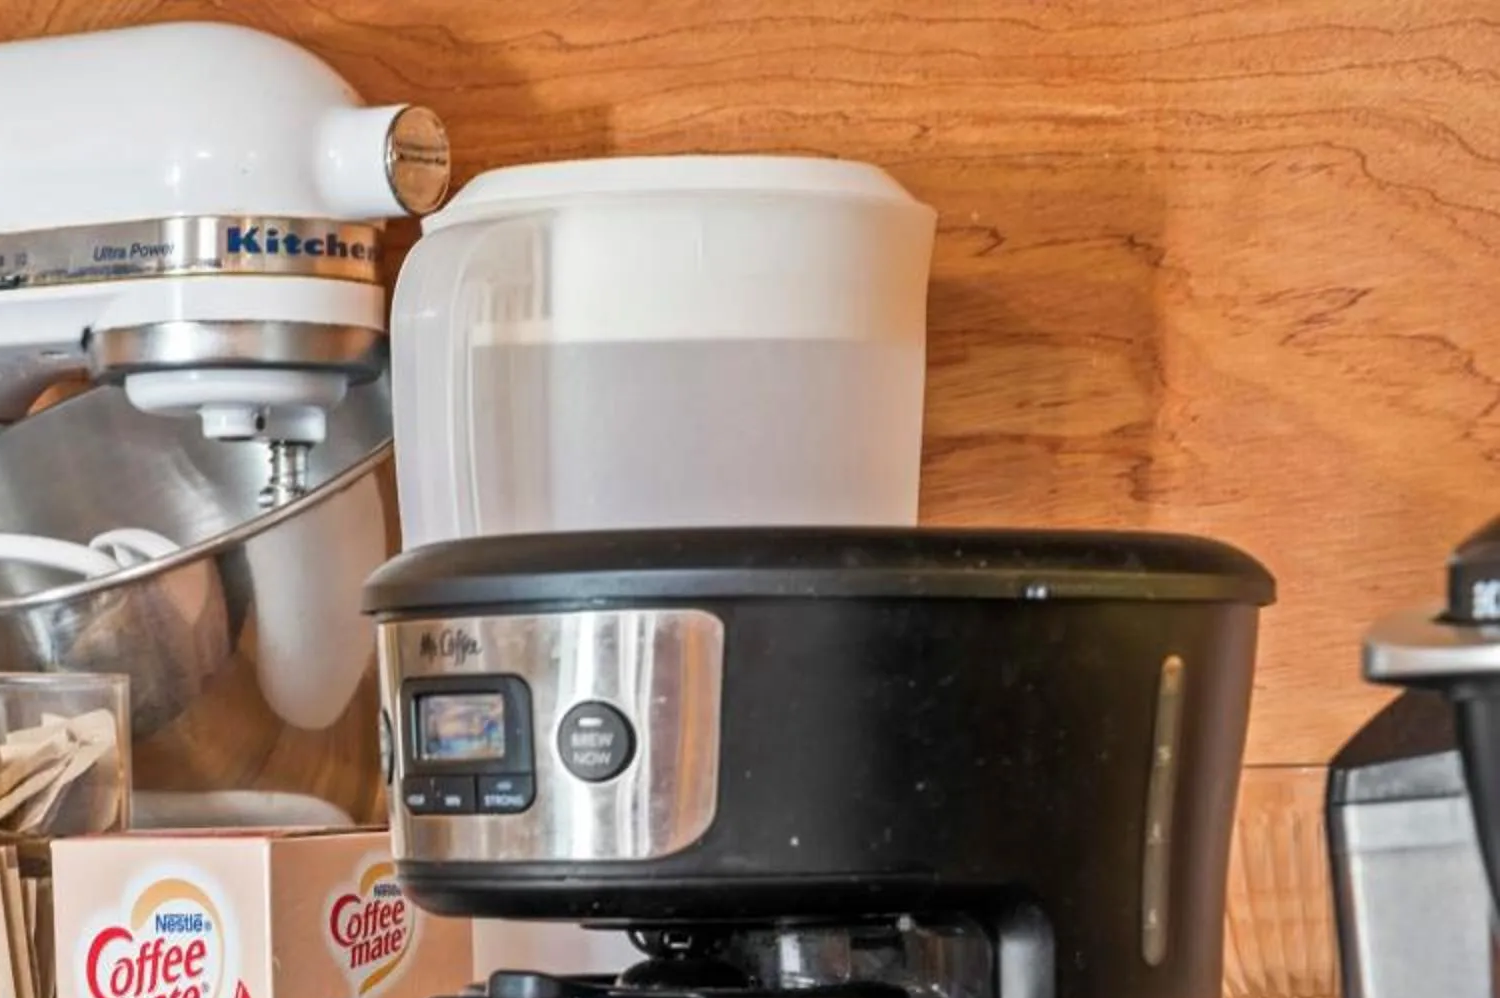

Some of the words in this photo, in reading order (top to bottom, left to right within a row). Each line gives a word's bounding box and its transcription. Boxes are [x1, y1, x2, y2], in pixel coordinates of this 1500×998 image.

[93, 244, 127, 262] Ultra
[130, 241, 176, 259] Power
[439, 628, 483, 667] Coffee
[571, 732, 615, 748] BREW
[572, 751, 613, 766] NOW
[483, 793, 526, 808] STRONG
[330, 894, 405, 948] Coffee
[350, 927, 404, 969] mate
